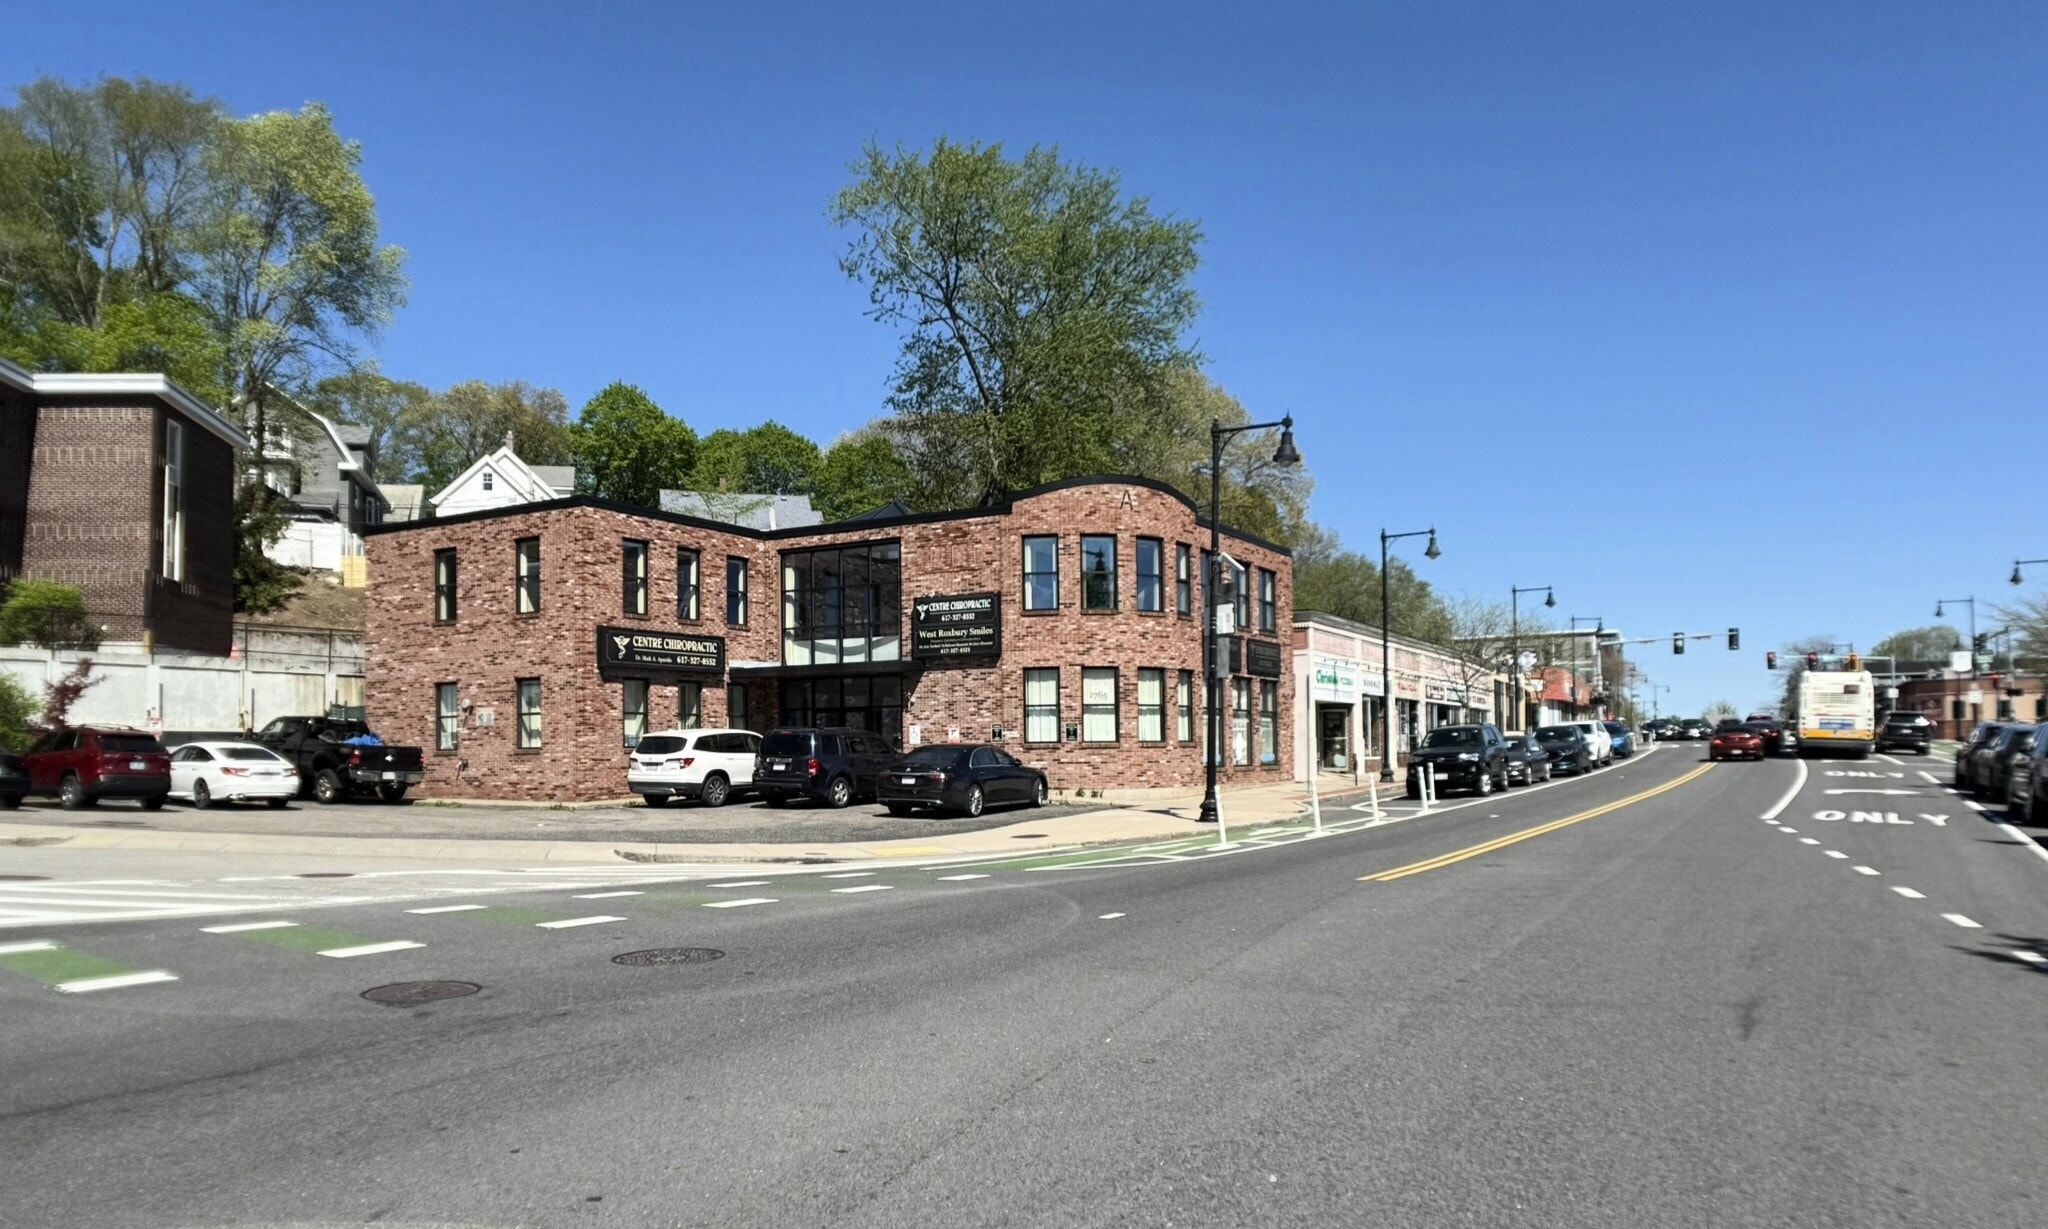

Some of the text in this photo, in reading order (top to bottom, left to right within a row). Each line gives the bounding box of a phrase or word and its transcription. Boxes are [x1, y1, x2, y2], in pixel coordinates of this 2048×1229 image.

[928, 598, 991, 611] CENTRE CHIROPRACTIC
[918, 626, 994, 639] West Roxbury Smiles
[632, 636, 718, 653] CENTRE CHIROPRACTIC
[676, 656, 717, 666] 617-327-8552
[1823, 771, 1905, 779] ONLY
[1812, 810, 1950, 826] ONLY
